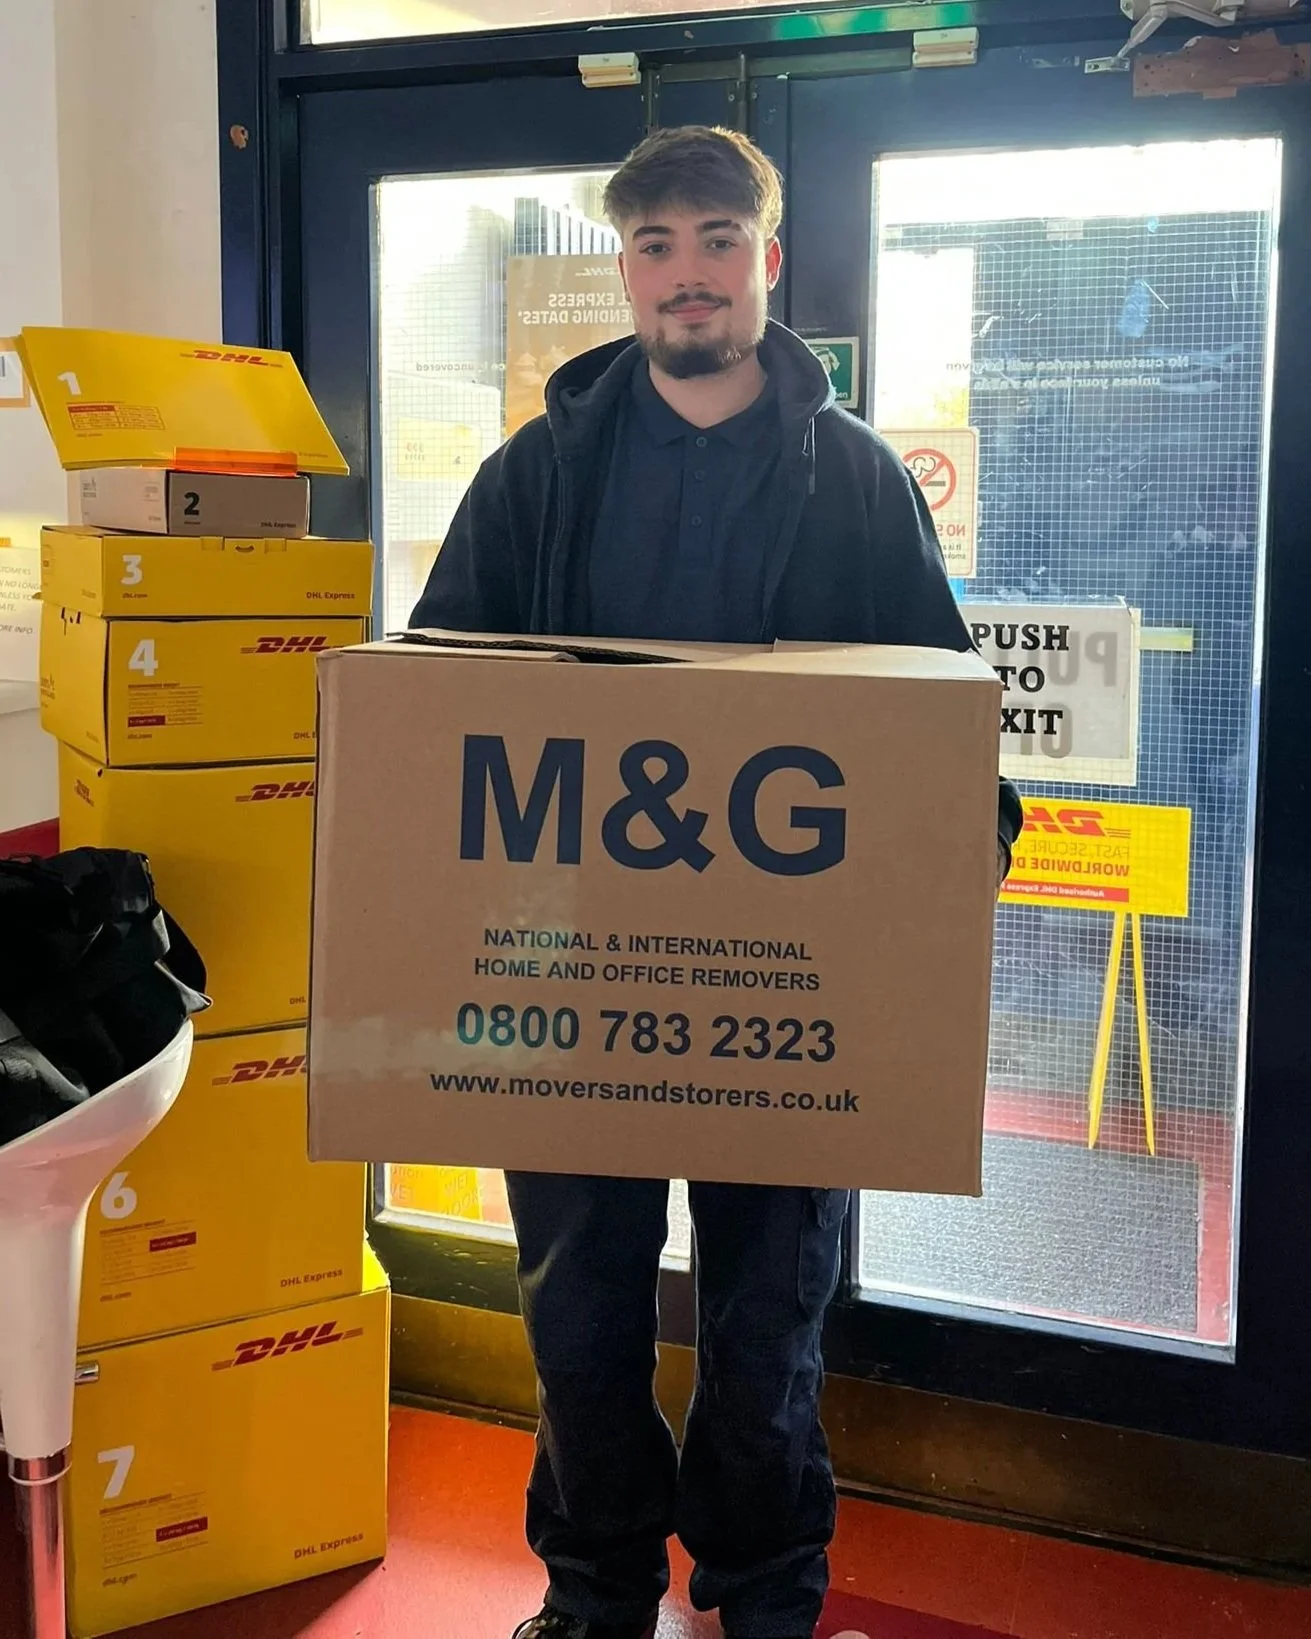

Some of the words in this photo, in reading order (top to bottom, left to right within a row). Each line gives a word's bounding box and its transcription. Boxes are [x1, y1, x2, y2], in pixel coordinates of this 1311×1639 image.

[193, 350, 269, 366] DHL
[58, 372, 81, 396] 1
[184, 492, 200, 516] 2
[121, 555, 143, 585] 3
[306, 591, 321, 599] DHL
[325, 591, 356, 600] Express
[255, 636, 331, 653] DHL
[970, 623, 1069, 651] PUSH
[128, 639, 158, 676] 4
[992, 666, 1045, 693] TO
[1000, 708, 1063, 735] XIT
[250, 781, 314, 801] DH
[459, 733, 847, 877] M&G
[484, 928, 598, 951] NATIONAL
[606, 934, 621, 951] &
[629, 935, 812, 961] INTERNATIONAL
[475, 957, 540, 978] HOME
[548, 960, 595, 980] AND
[602, 964, 684, 985] OFFICE
[692, 968, 820, 991] REMOVERS
[457, 1003, 580, 1050] 0800
[600, 1009, 692, 1056] 783
[709, 1015, 836, 1062] 2323
[231, 1055, 306, 1083] DH
[430, 1072, 859, 1113] www.moversandstorers.co.uk
[101, 1172, 137, 1219] 6
[280, 1276, 302, 1288] DHL
[303, 1269, 343, 1283] Express
[233, 1321, 344, 1367] DHL
[98, 1446, 135, 1499] 7
[294, 1545, 317, 1559] DHL
[320, 1532, 364, 1552] Express
